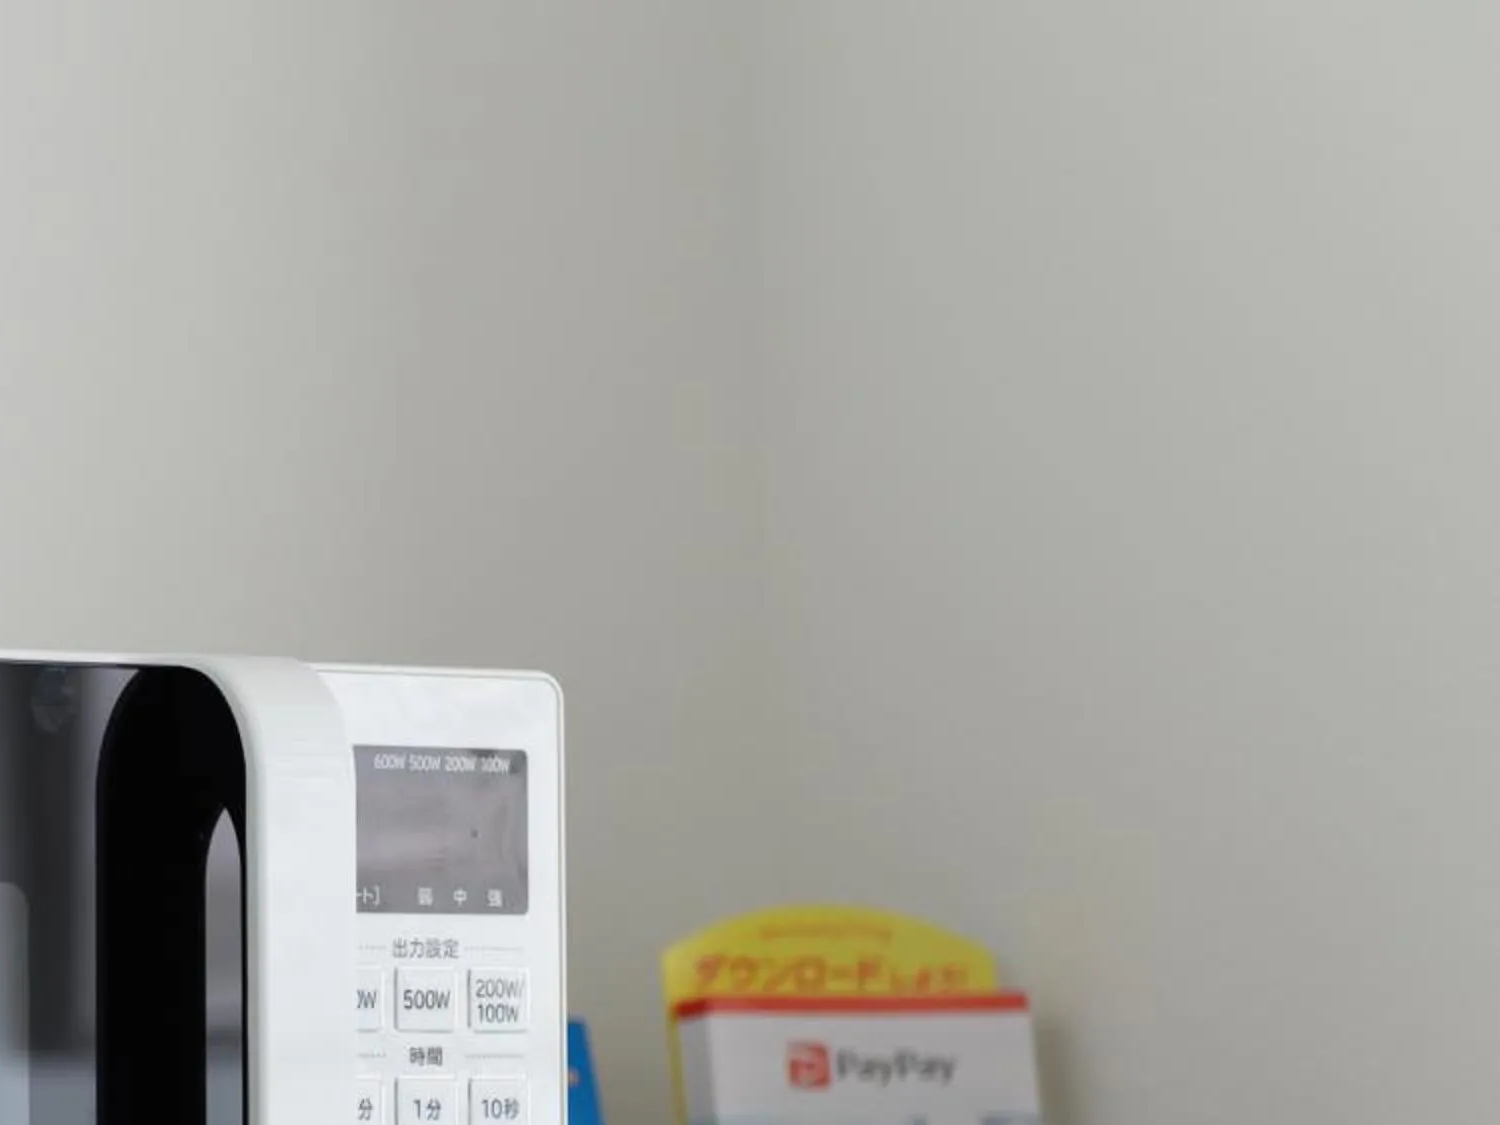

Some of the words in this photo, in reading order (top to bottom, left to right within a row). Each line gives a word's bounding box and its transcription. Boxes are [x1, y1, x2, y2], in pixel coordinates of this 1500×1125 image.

[454, 889, 467, 906] 中
[392, 937, 460, 958] 出力設定
[475, 979, 525, 998] 200W/
[403, 989, 450, 1009] 500W
[478, 1004, 519, 1023] 100W
[409, 1046, 443, 1066] 時間
[836, 1046, 956, 1087] PayPay
[413, 1098, 441, 1121] 1分
[481, 1098, 520, 1120] 10秒
